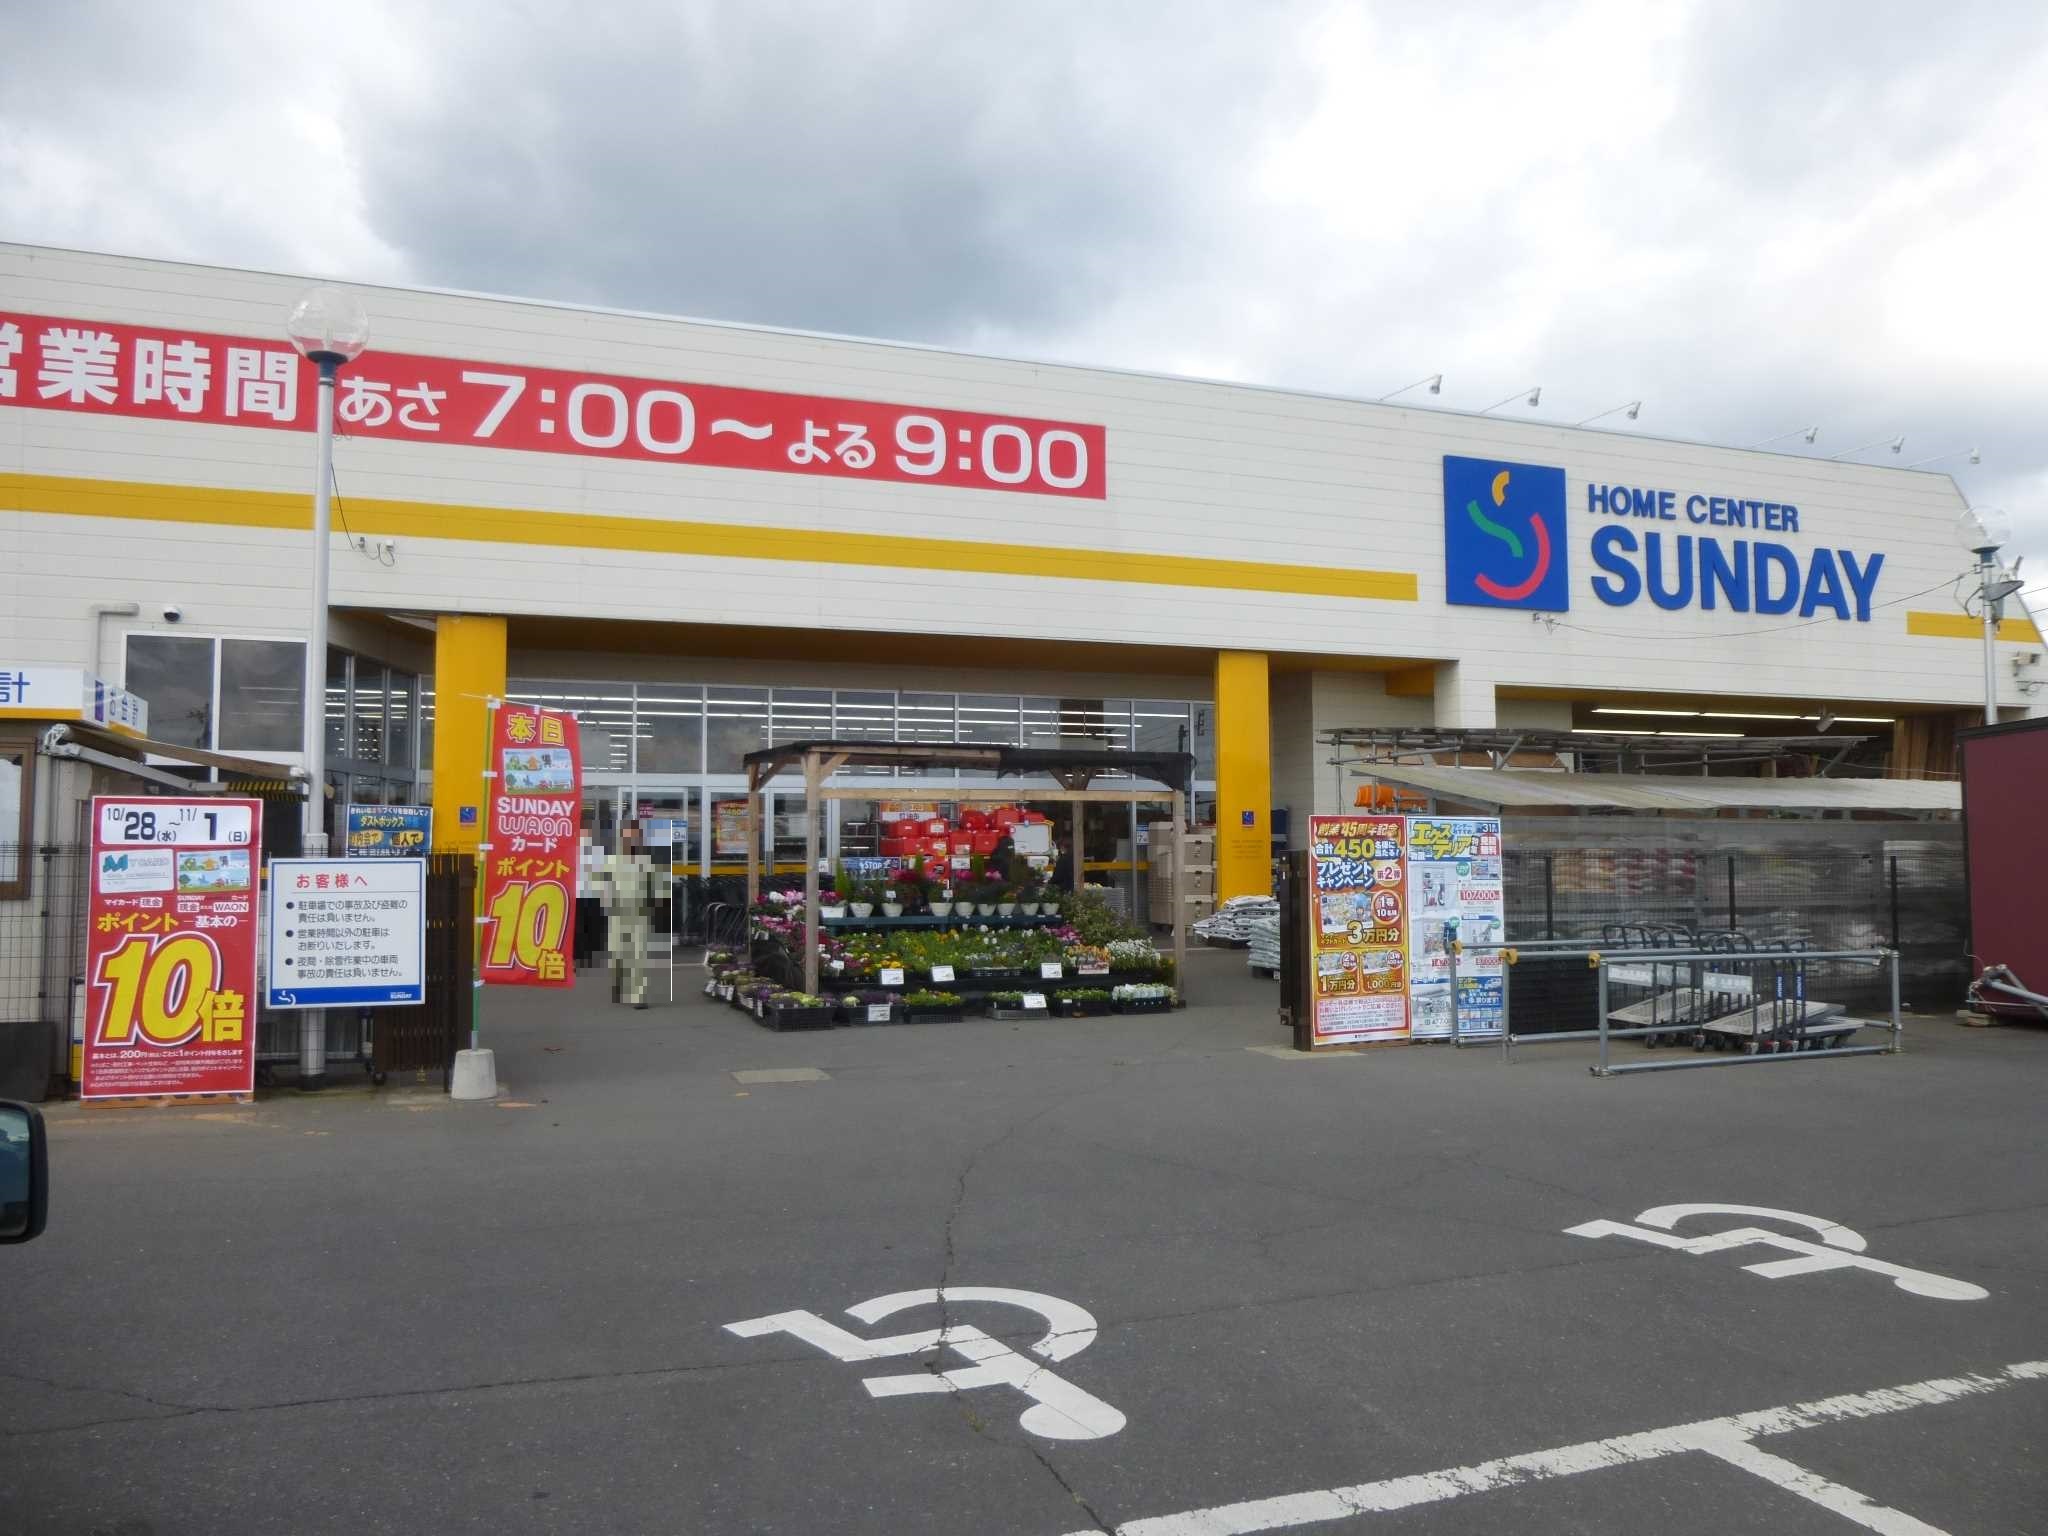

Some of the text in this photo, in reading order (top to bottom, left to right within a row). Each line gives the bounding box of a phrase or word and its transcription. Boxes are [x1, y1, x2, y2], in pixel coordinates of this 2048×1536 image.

[1588, 483, 1799, 532] HOME CENTER
[1590, 525, 1885, 622] SUNDAY
[507, 713, 564, 745] 本日
[497, 797, 575, 816] SUNDAY
[511, 838, 558, 852] カード
[496, 857, 570, 879] ポイント
[1316, 860, 1372, 875] プレゼント
[296, 874, 368, 888] お客様へ
[215, 903, 247, 911] WAON
[97, 912, 179, 932] ポイント
[195, 915, 238, 928] 基本の
[1346, 920, 1400, 944] 3万円分
[96, 932, 245, 1044] 10倍
